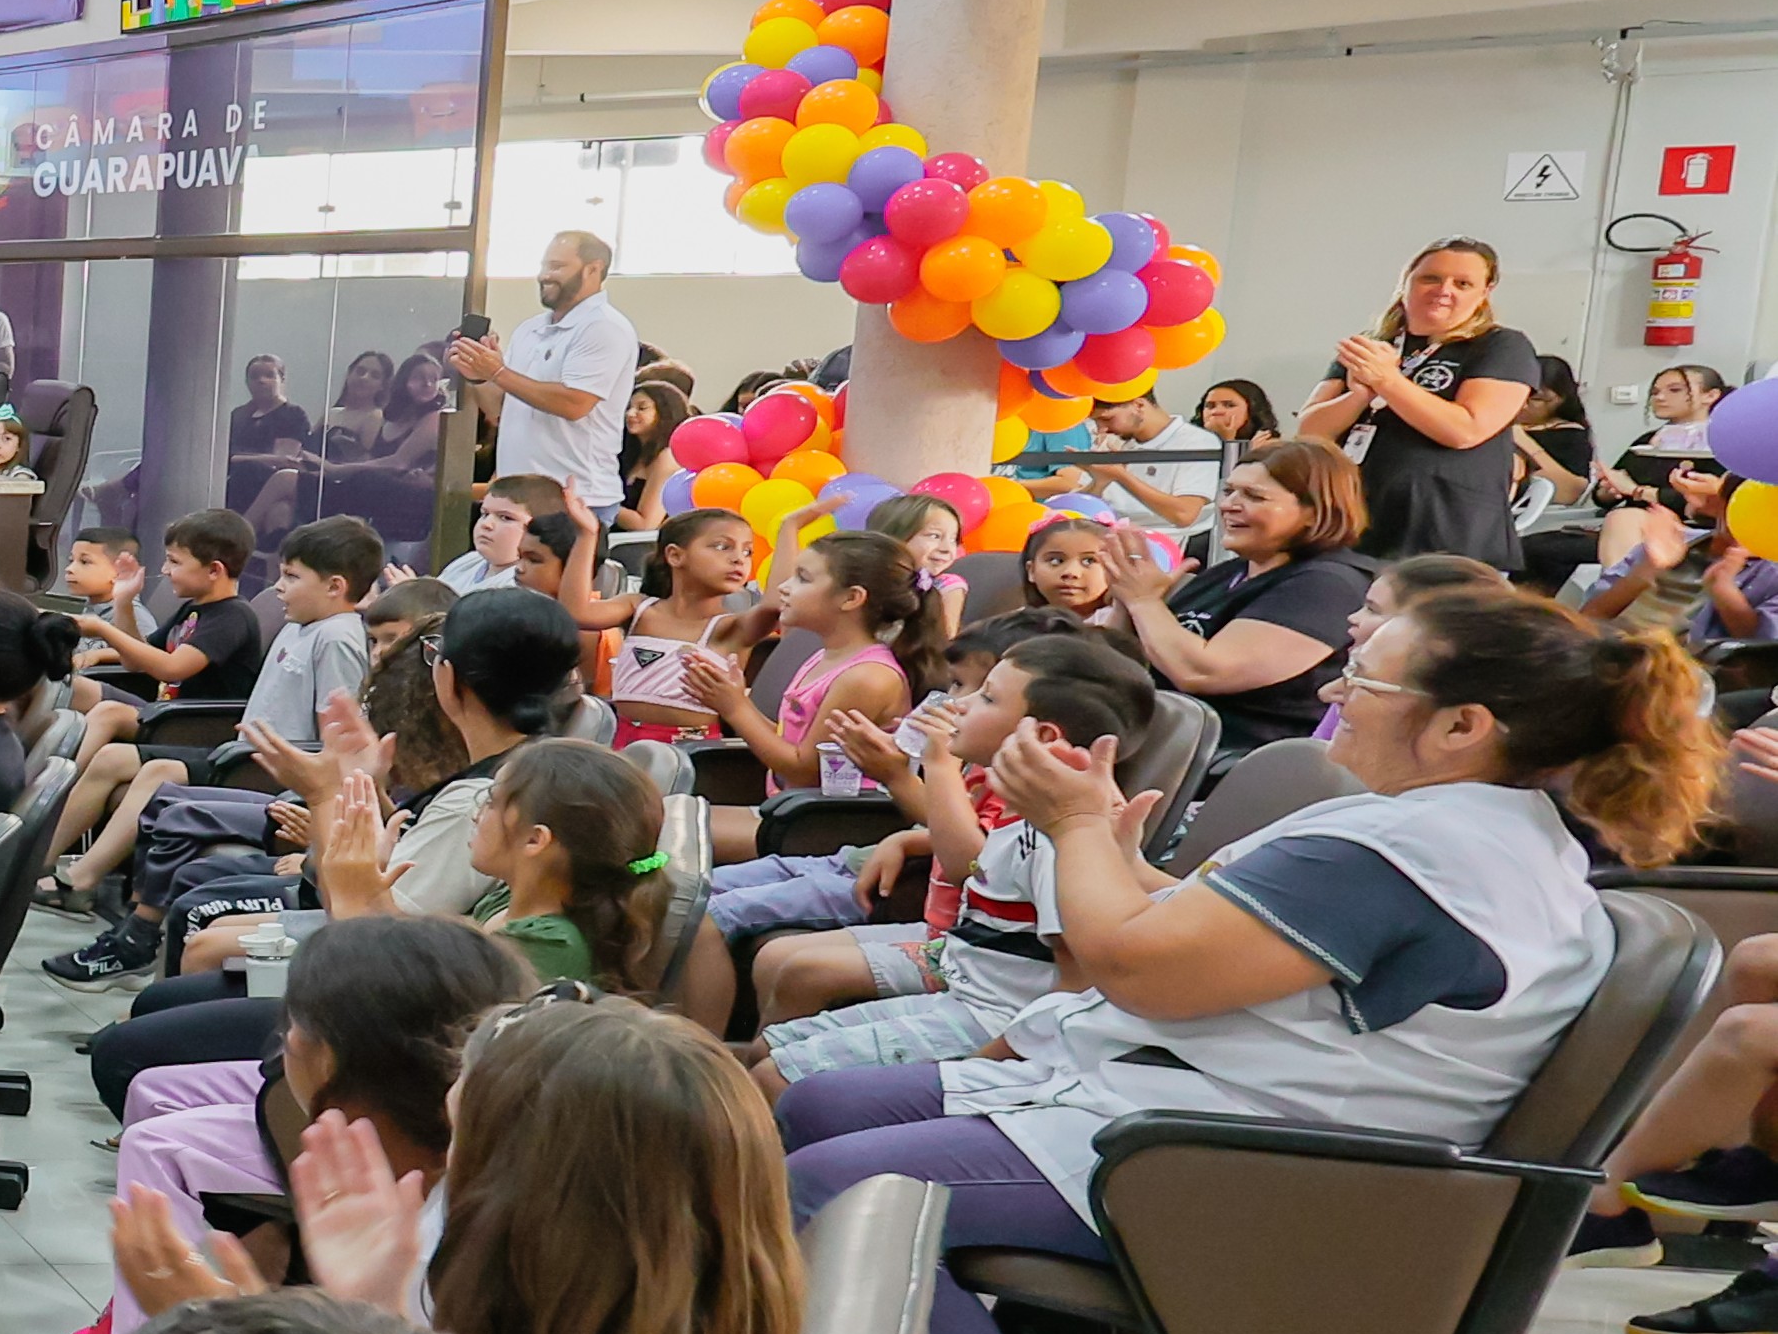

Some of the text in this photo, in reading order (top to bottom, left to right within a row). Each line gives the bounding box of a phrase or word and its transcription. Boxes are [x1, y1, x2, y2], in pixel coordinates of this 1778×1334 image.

[36, 100, 268, 151] CÂMARA DE
[236, 897, 284, 913] PLAY
